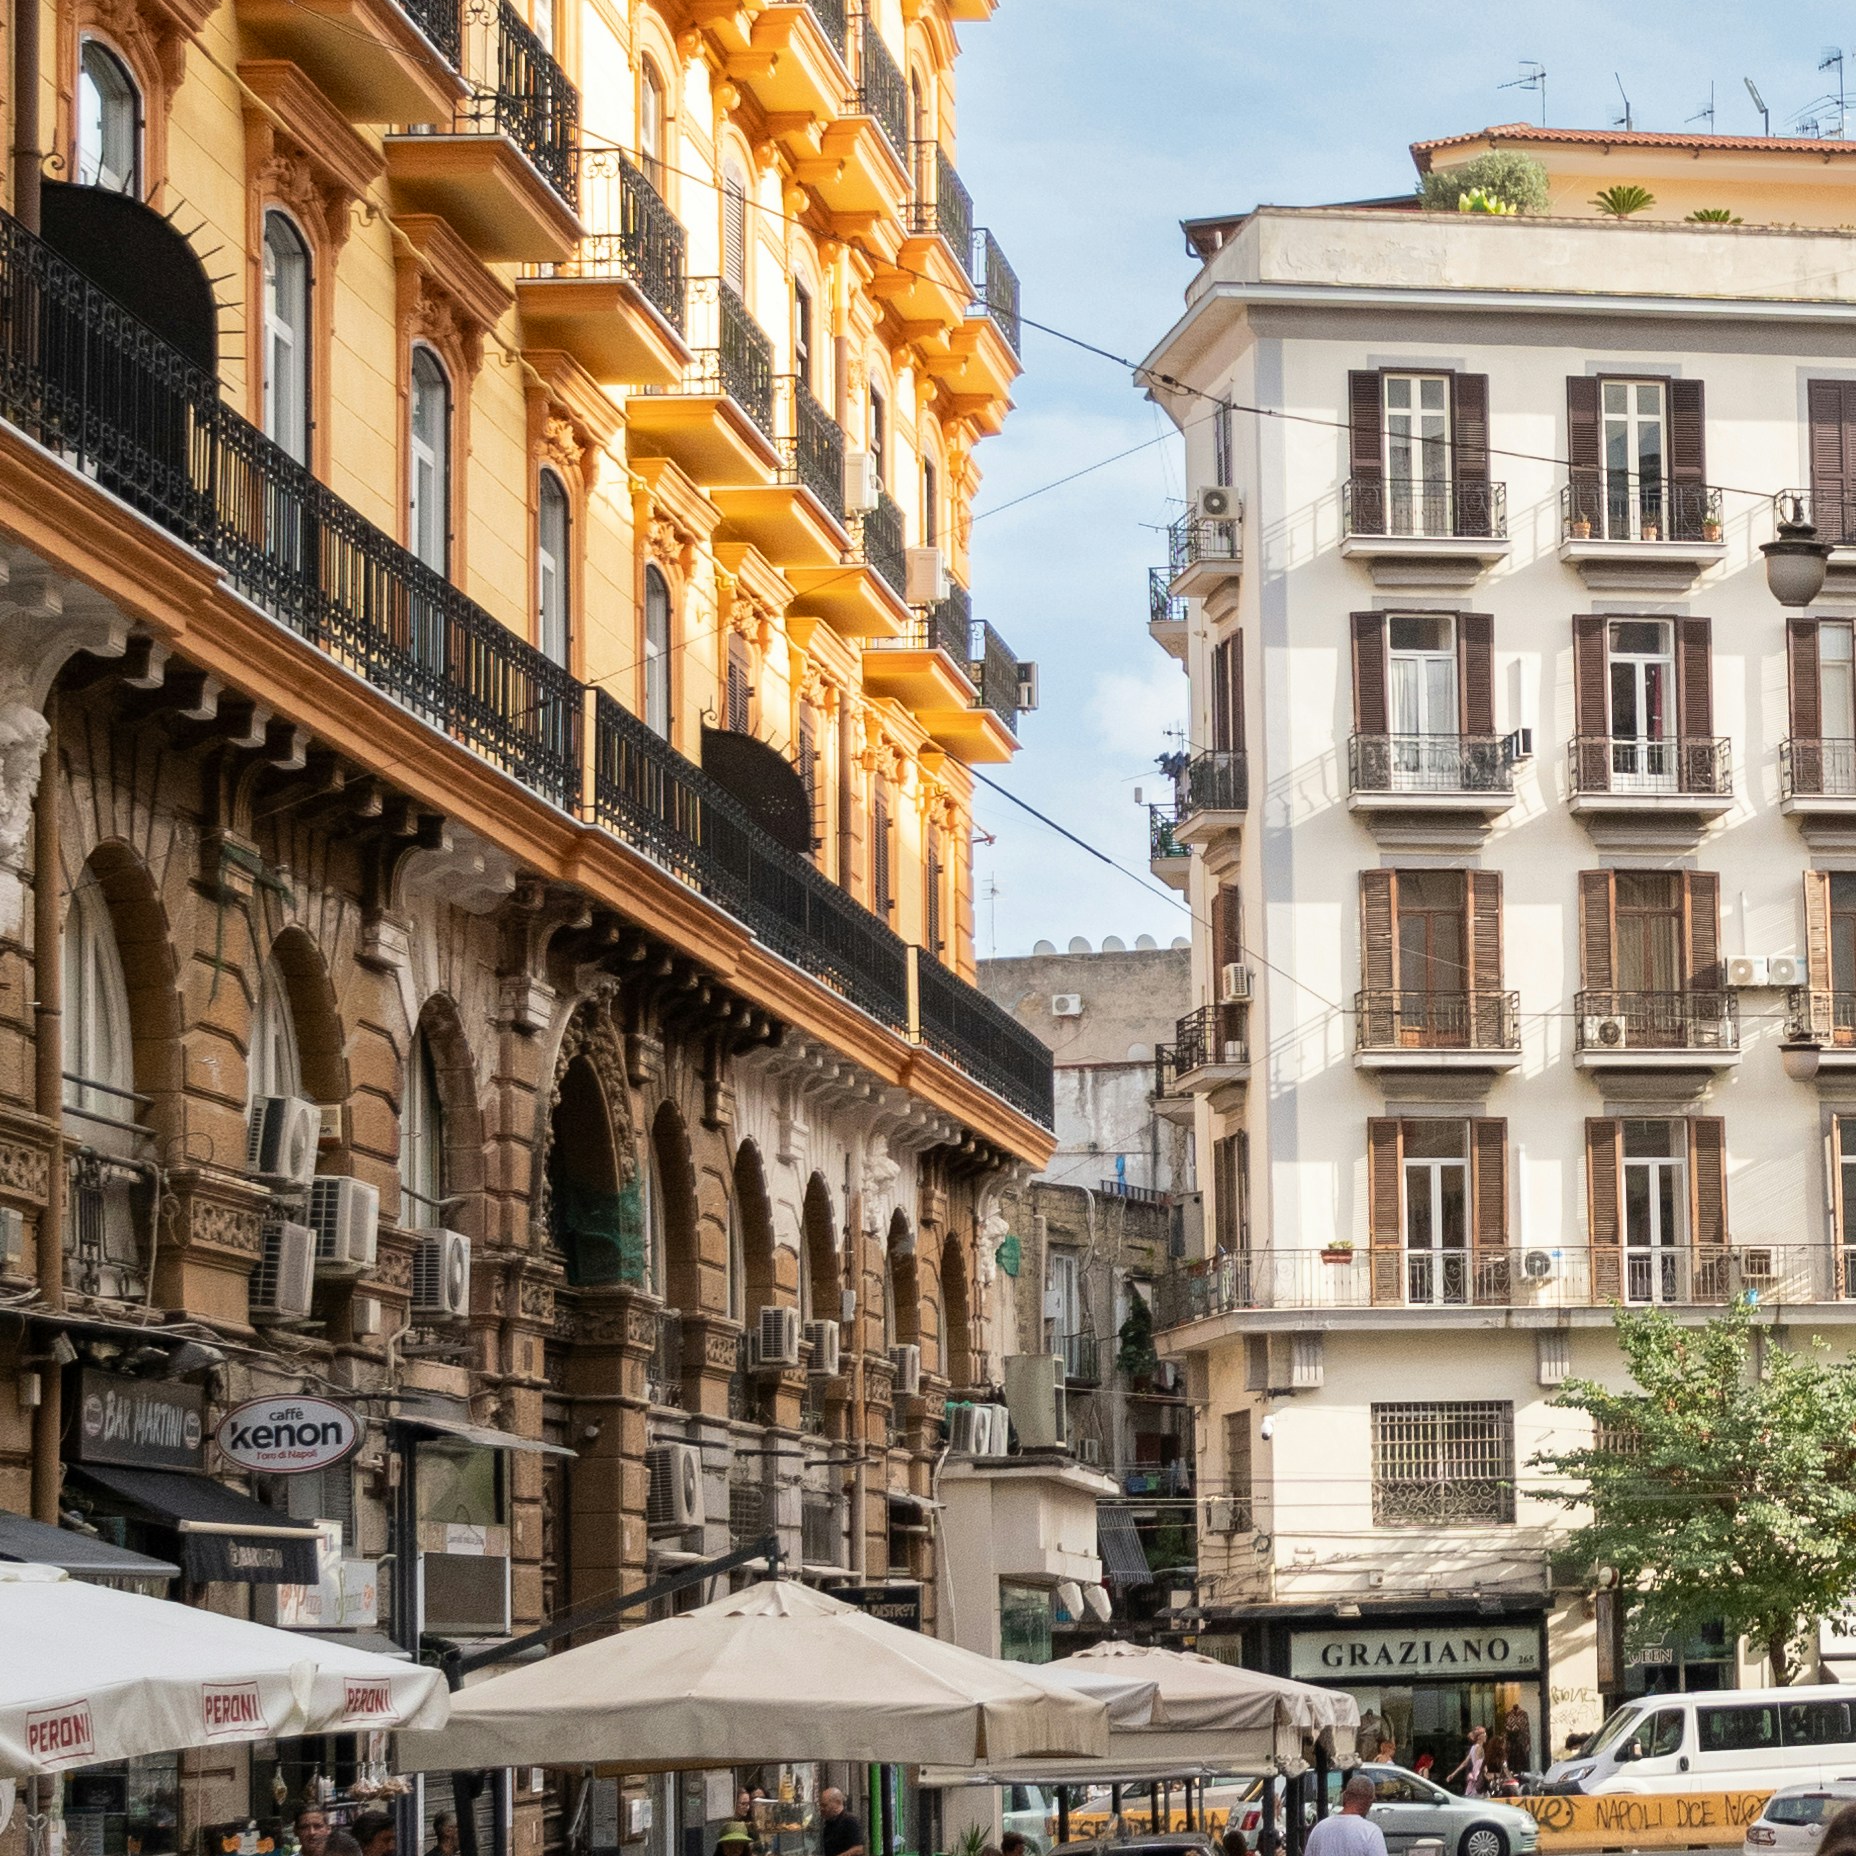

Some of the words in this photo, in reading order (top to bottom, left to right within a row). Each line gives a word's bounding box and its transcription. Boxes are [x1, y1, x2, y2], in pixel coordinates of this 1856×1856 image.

[230, 1422, 342, 1449] kenon
[288, 1449, 318, 1460] Napoli
[1321, 1638, 1511, 1668] GRAZIANO
[1518, 1654, 1535, 1665] 265
[205, 1693, 260, 1725] PERONI
[347, 1687, 391, 1714] PERONI
[28, 1712, 91, 1753] PERONI
[1596, 1798, 1662, 1831] NAPOLI
